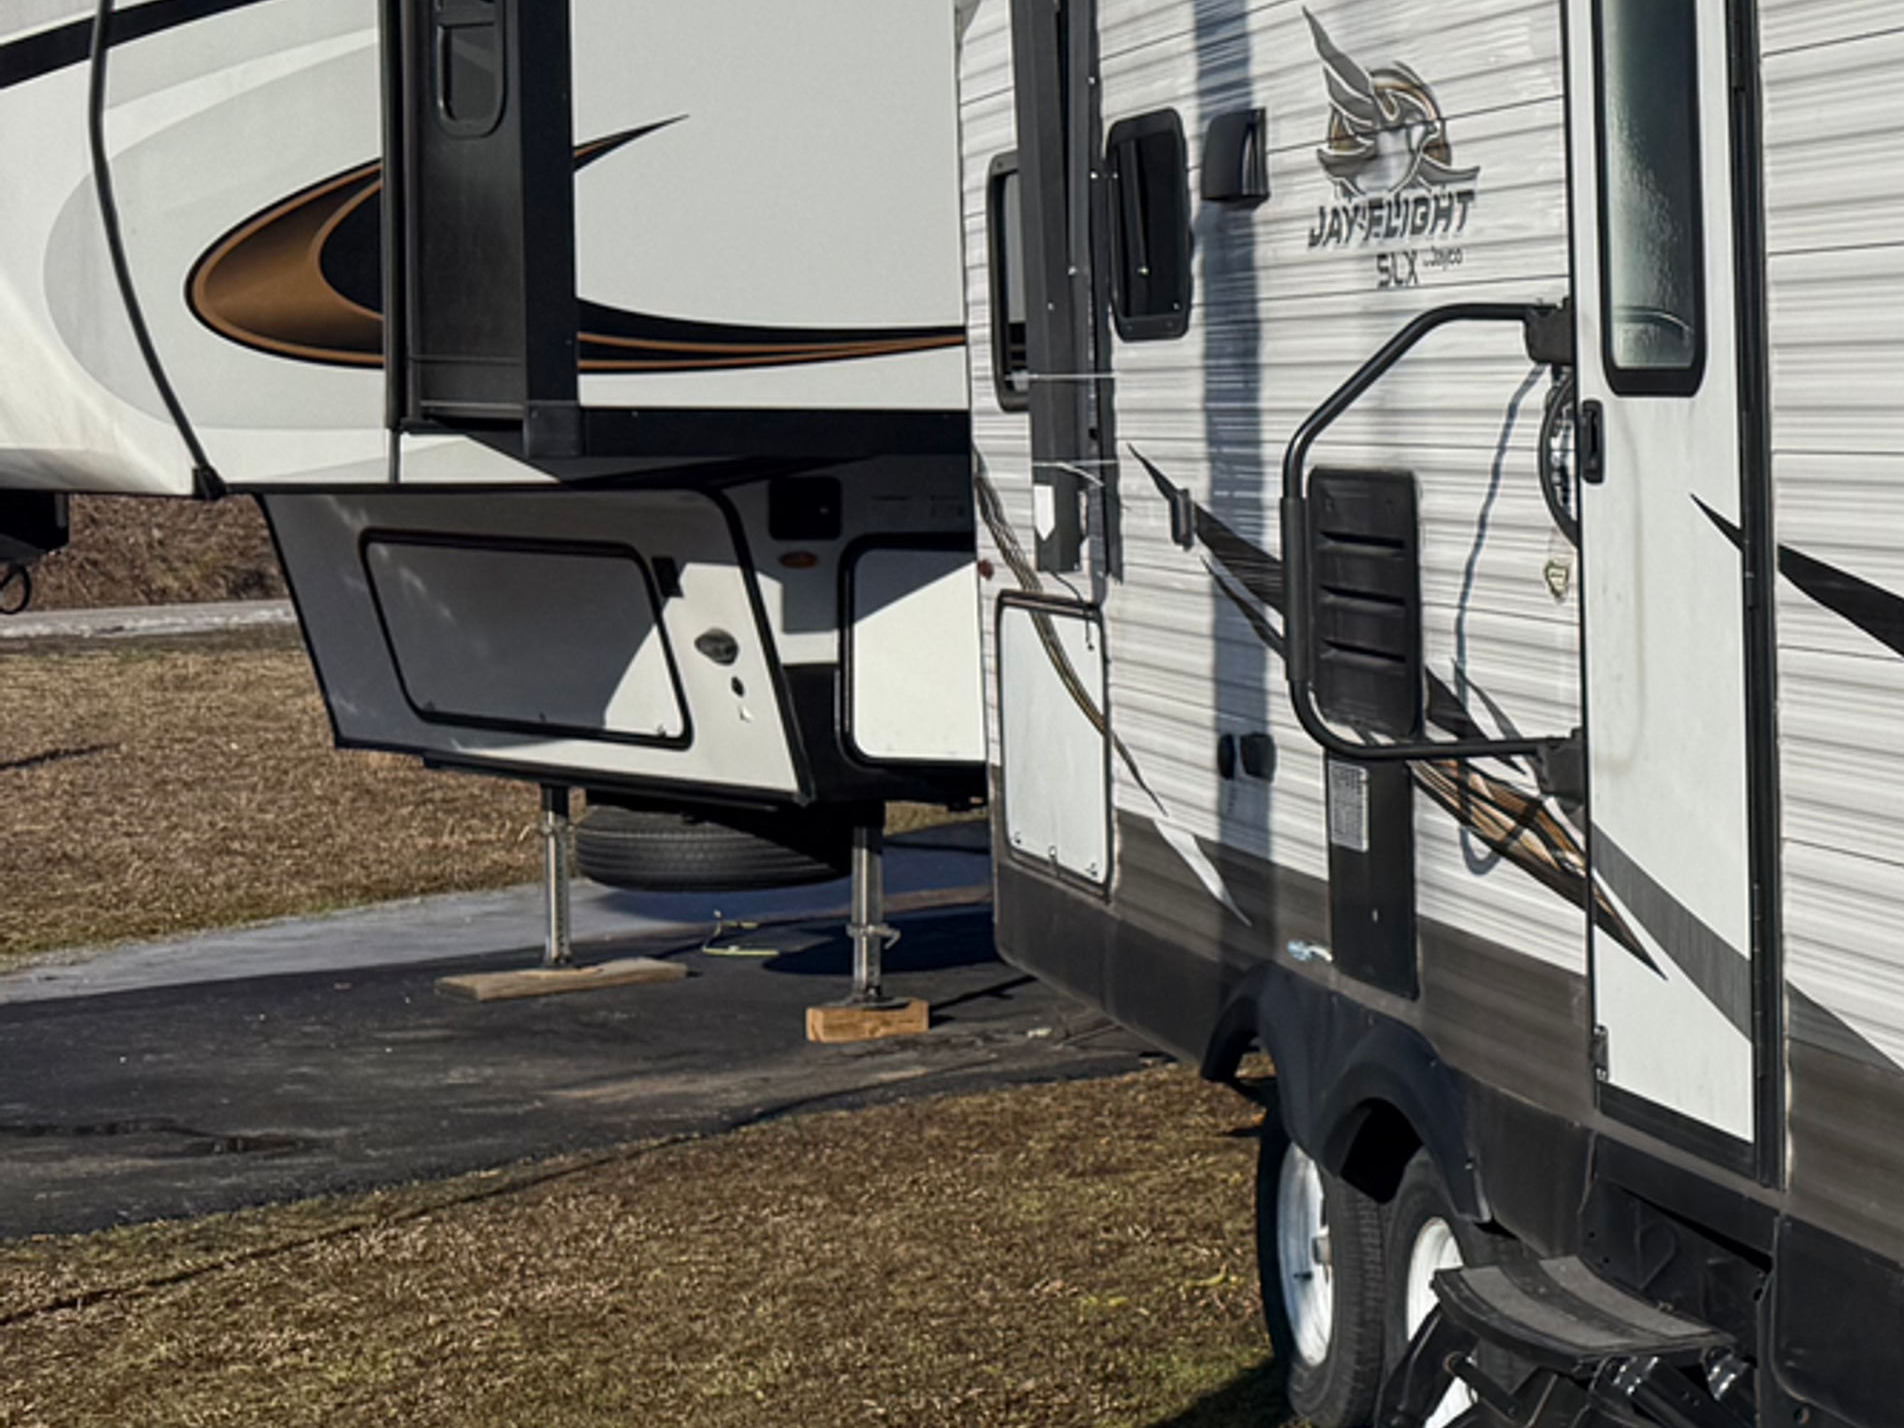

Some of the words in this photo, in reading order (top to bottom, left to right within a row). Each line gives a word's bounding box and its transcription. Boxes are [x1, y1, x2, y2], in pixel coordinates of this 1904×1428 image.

[1307, 204, 1363, 248] JAY
[1363, 189, 1476, 242] FLIGHT
[1376, 251, 1420, 289] SLX
